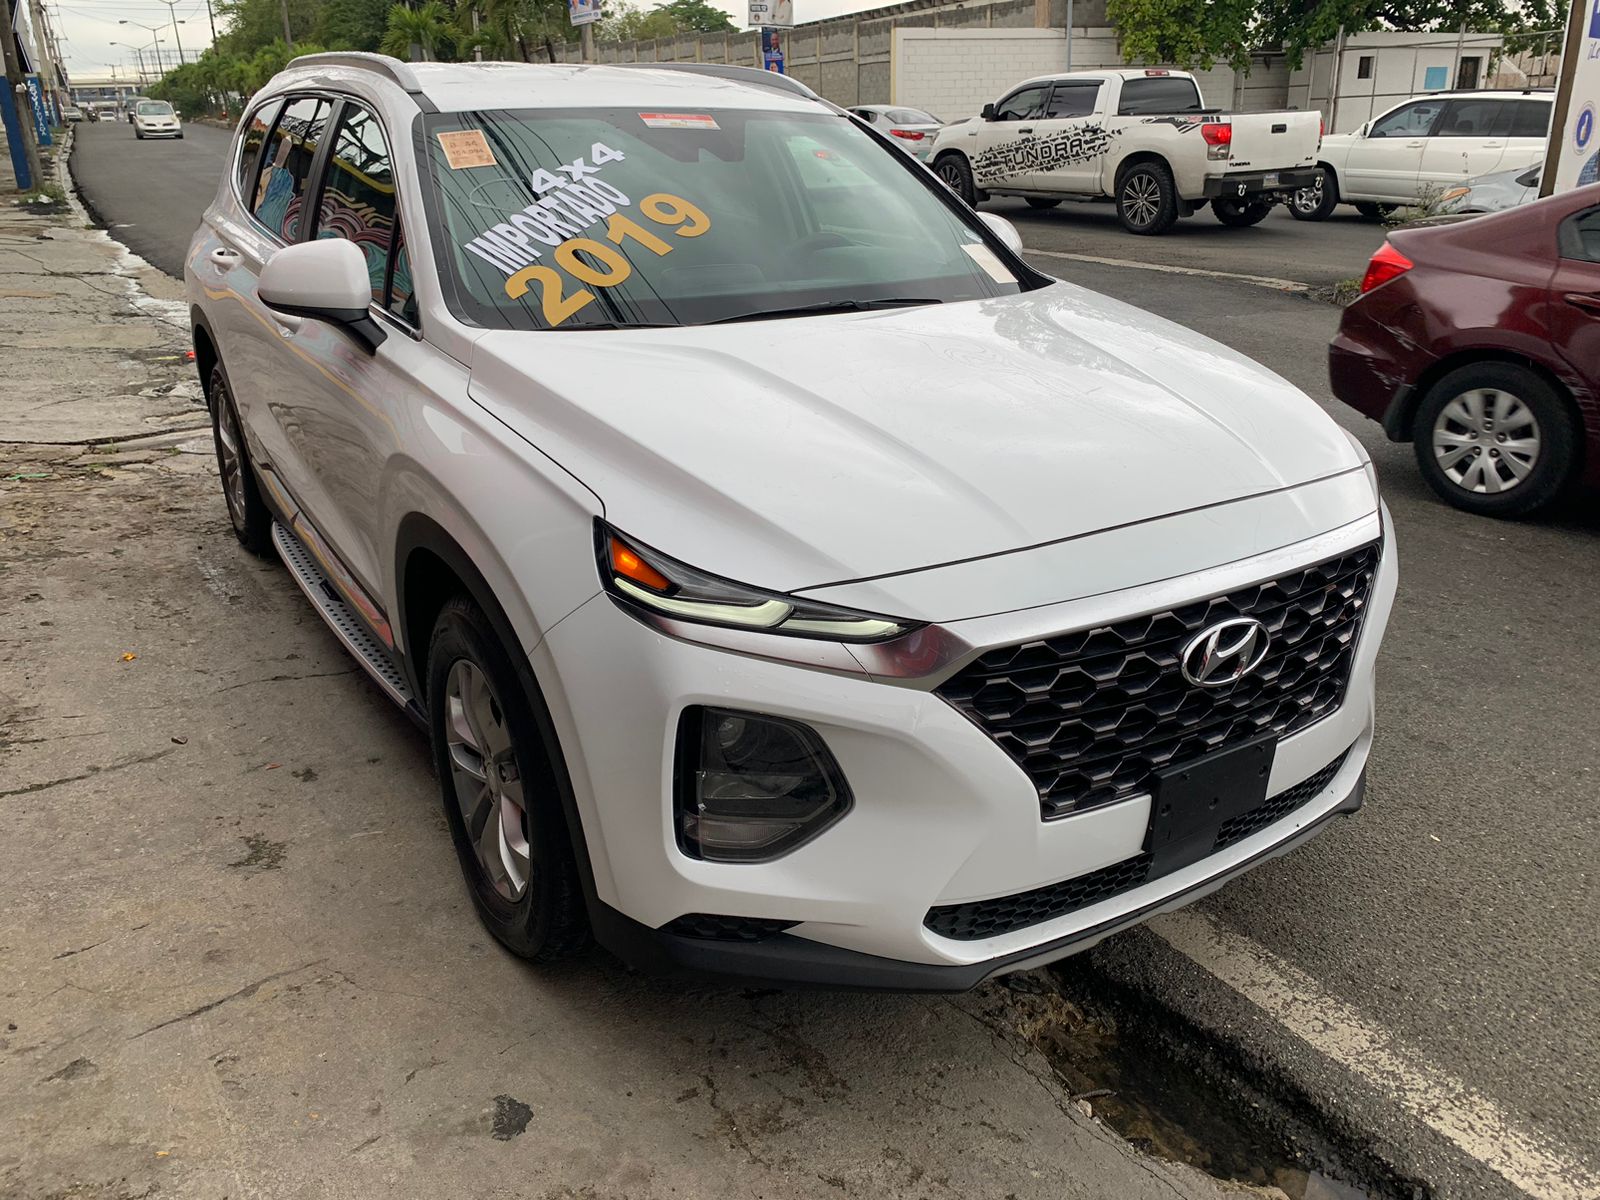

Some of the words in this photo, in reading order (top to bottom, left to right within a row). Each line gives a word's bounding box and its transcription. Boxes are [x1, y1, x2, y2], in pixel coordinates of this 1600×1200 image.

[531, 142, 626, 195] 4x4
[1001, 138, 1083, 168] TUNDRA
[463, 175, 632, 276] IMPORTADO
[504, 193, 711, 327] 2019
